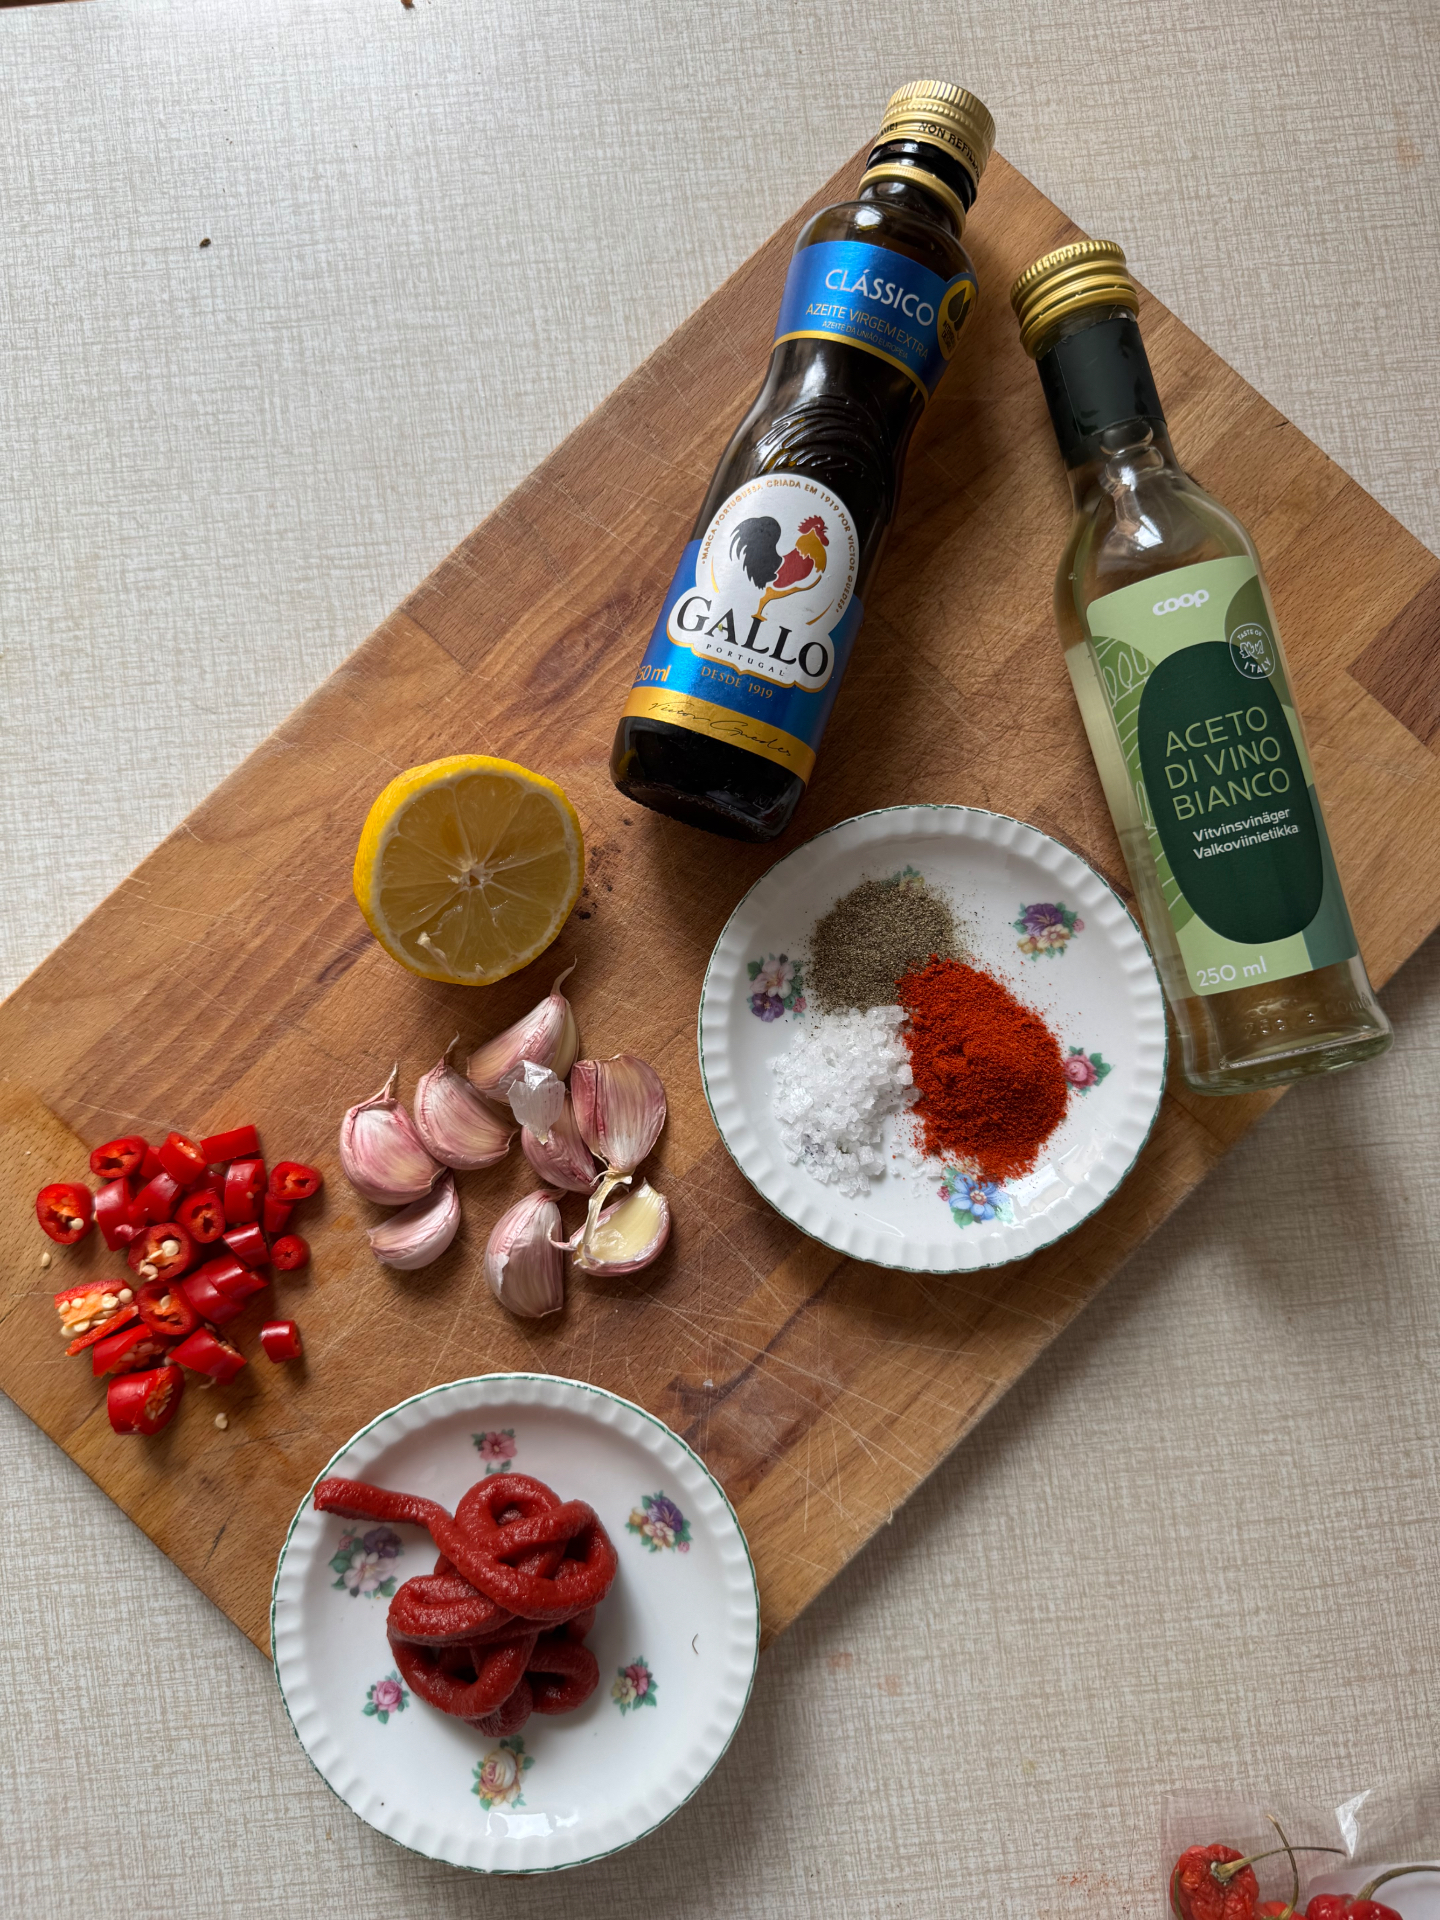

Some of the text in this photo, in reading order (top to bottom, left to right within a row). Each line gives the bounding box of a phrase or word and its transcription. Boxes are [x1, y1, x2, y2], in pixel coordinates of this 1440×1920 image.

[918, 121, 945, 138] NON
[825, 268, 935, 326] CLÁSSICO
[805, 303, 847, 319] AZEITE
[849, 308, 897, 338] VIRGEM
[896, 329, 929, 360] EXTRA
[822, 320, 846, 332] AZEITE
[845, 325, 856, 335] DA
[701, 479, 856, 609] MARCA PORTUGUESA CRIADA EM 1919 POR VICTOR GUEDES
[1152, 589, 1209, 616] coop
[676, 596, 829, 677] GALLO
[1237, 629, 1254, 641] TASTE
[651, 664, 671, 682] ml
[706, 643, 785, 677] PORTUGAL
[1244, 657, 1271, 674] ITALY
[701, 666, 773, 699] DESDE 1919
[1166, 706, 1268, 757] ACETO
[1164, 736, 1280, 789] DI VINO
[1172, 767, 1290, 821] BIANCO
[1192, 808, 1291, 842] Vitvinsvinäger
[1193, 824, 1299, 860] Valkoviinietikka
[1196, 955, 1267, 987] 250 ml
